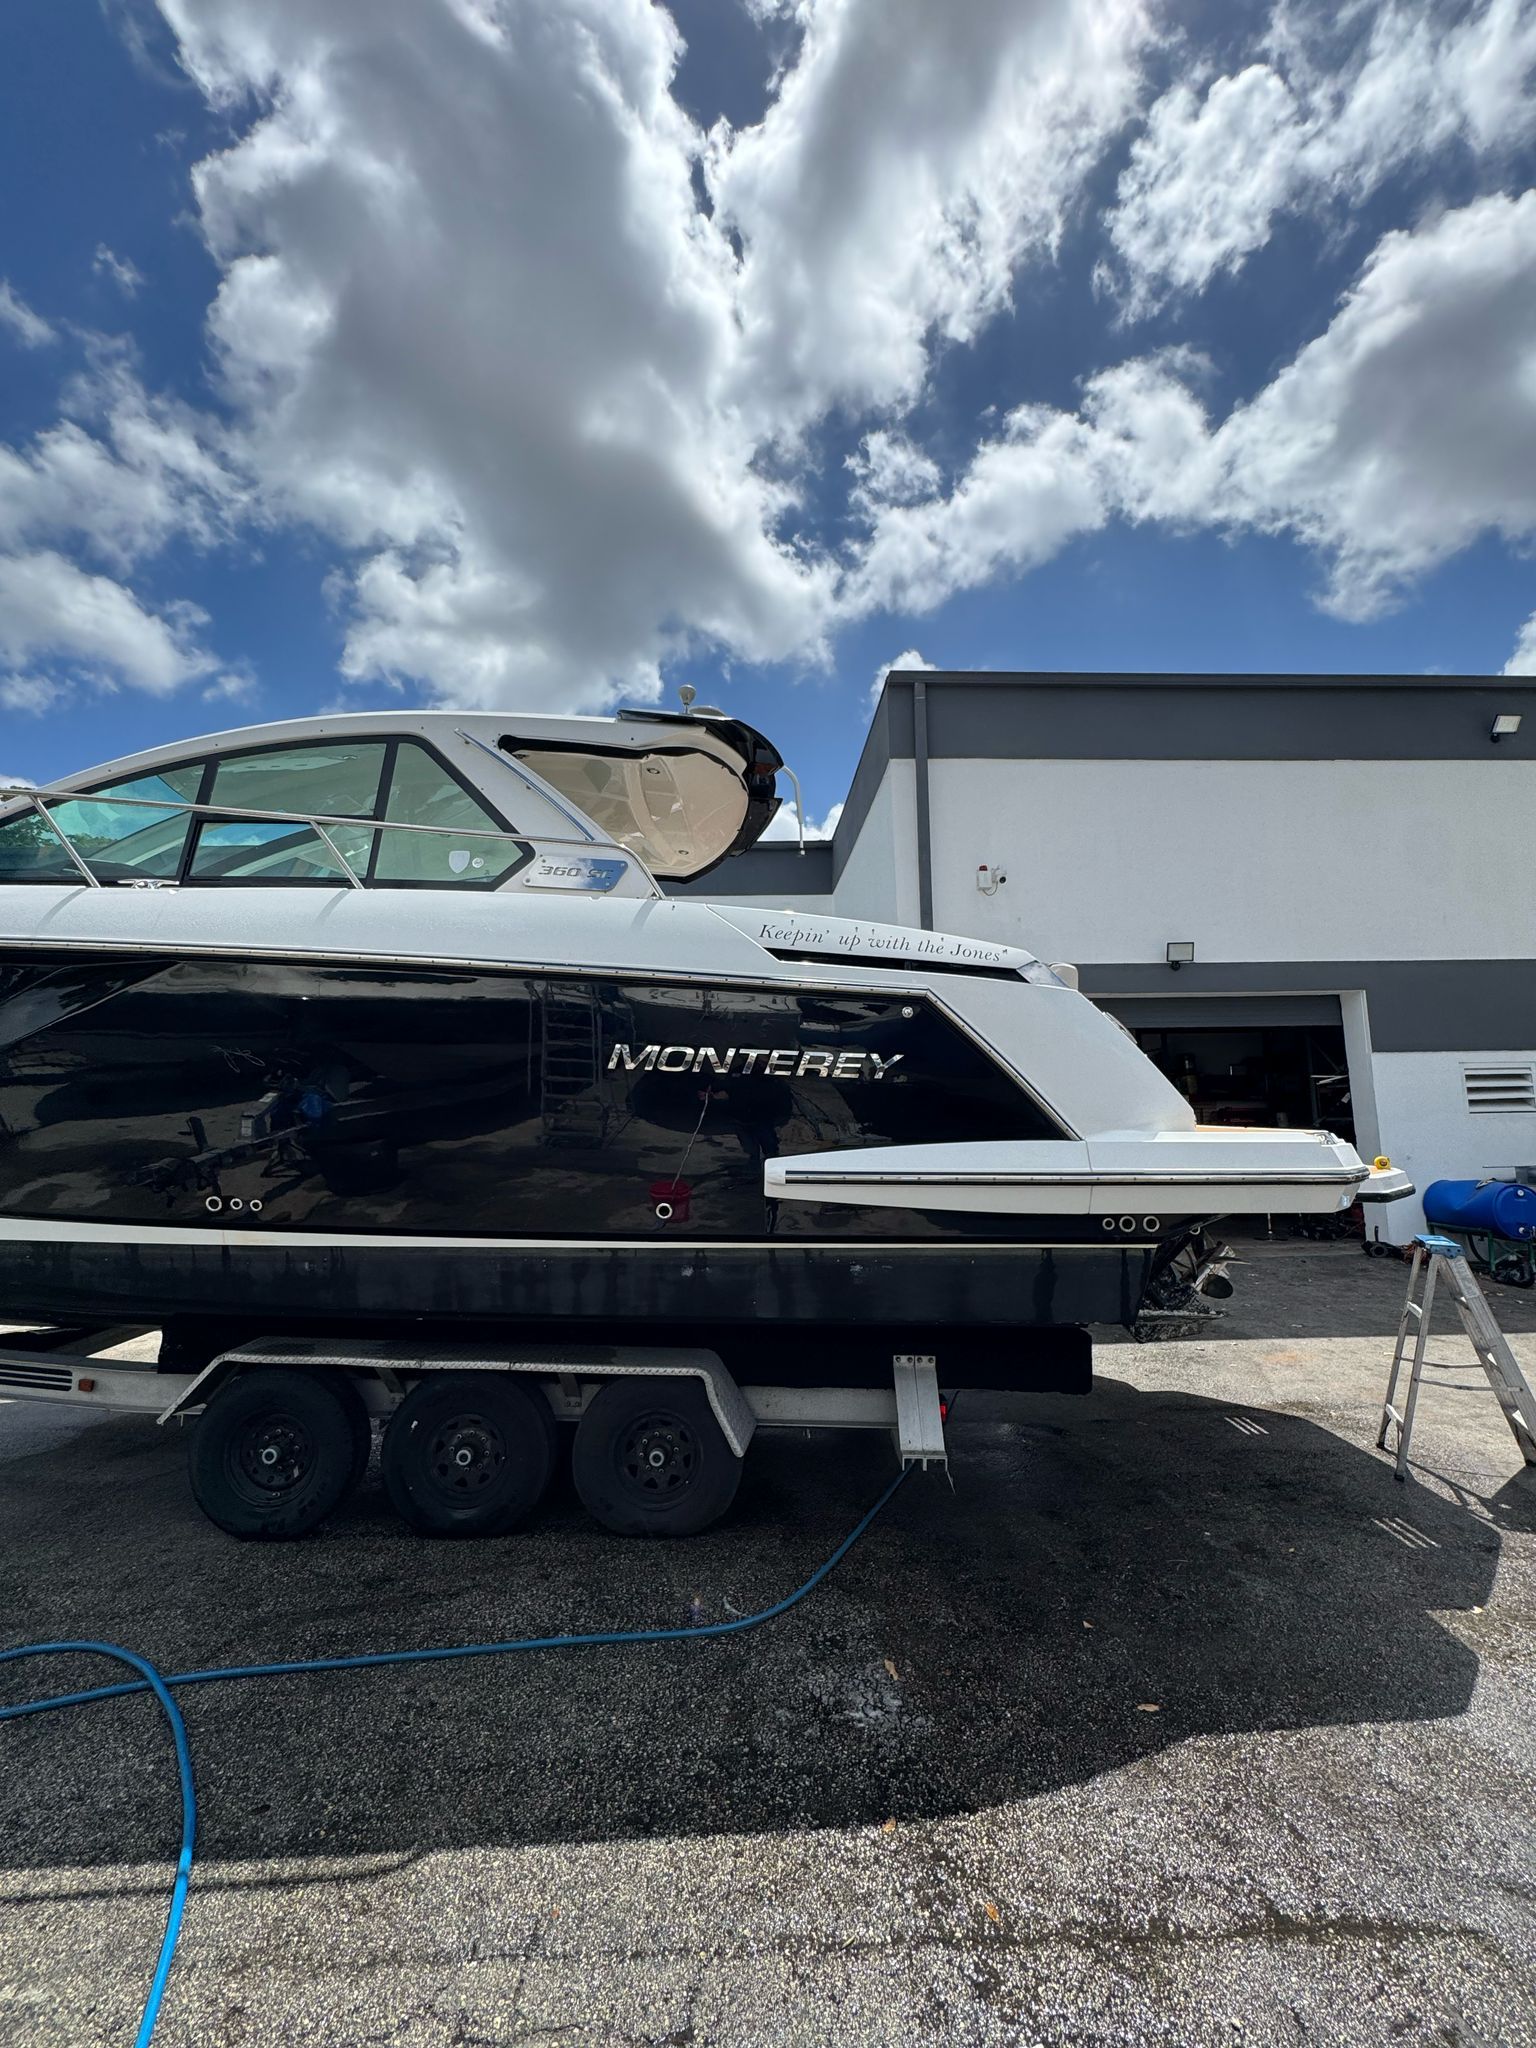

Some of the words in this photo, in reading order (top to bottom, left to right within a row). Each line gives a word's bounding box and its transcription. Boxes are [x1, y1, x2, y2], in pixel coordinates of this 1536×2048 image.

[537, 865, 582, 877] 360
[759, 924, 830, 946] Keepin'
[839, 934, 861, 951] up
[868, 936, 911, 951] with
[917, 939, 944, 955] the
[607, 1043, 904, 1079] MONTEREY
